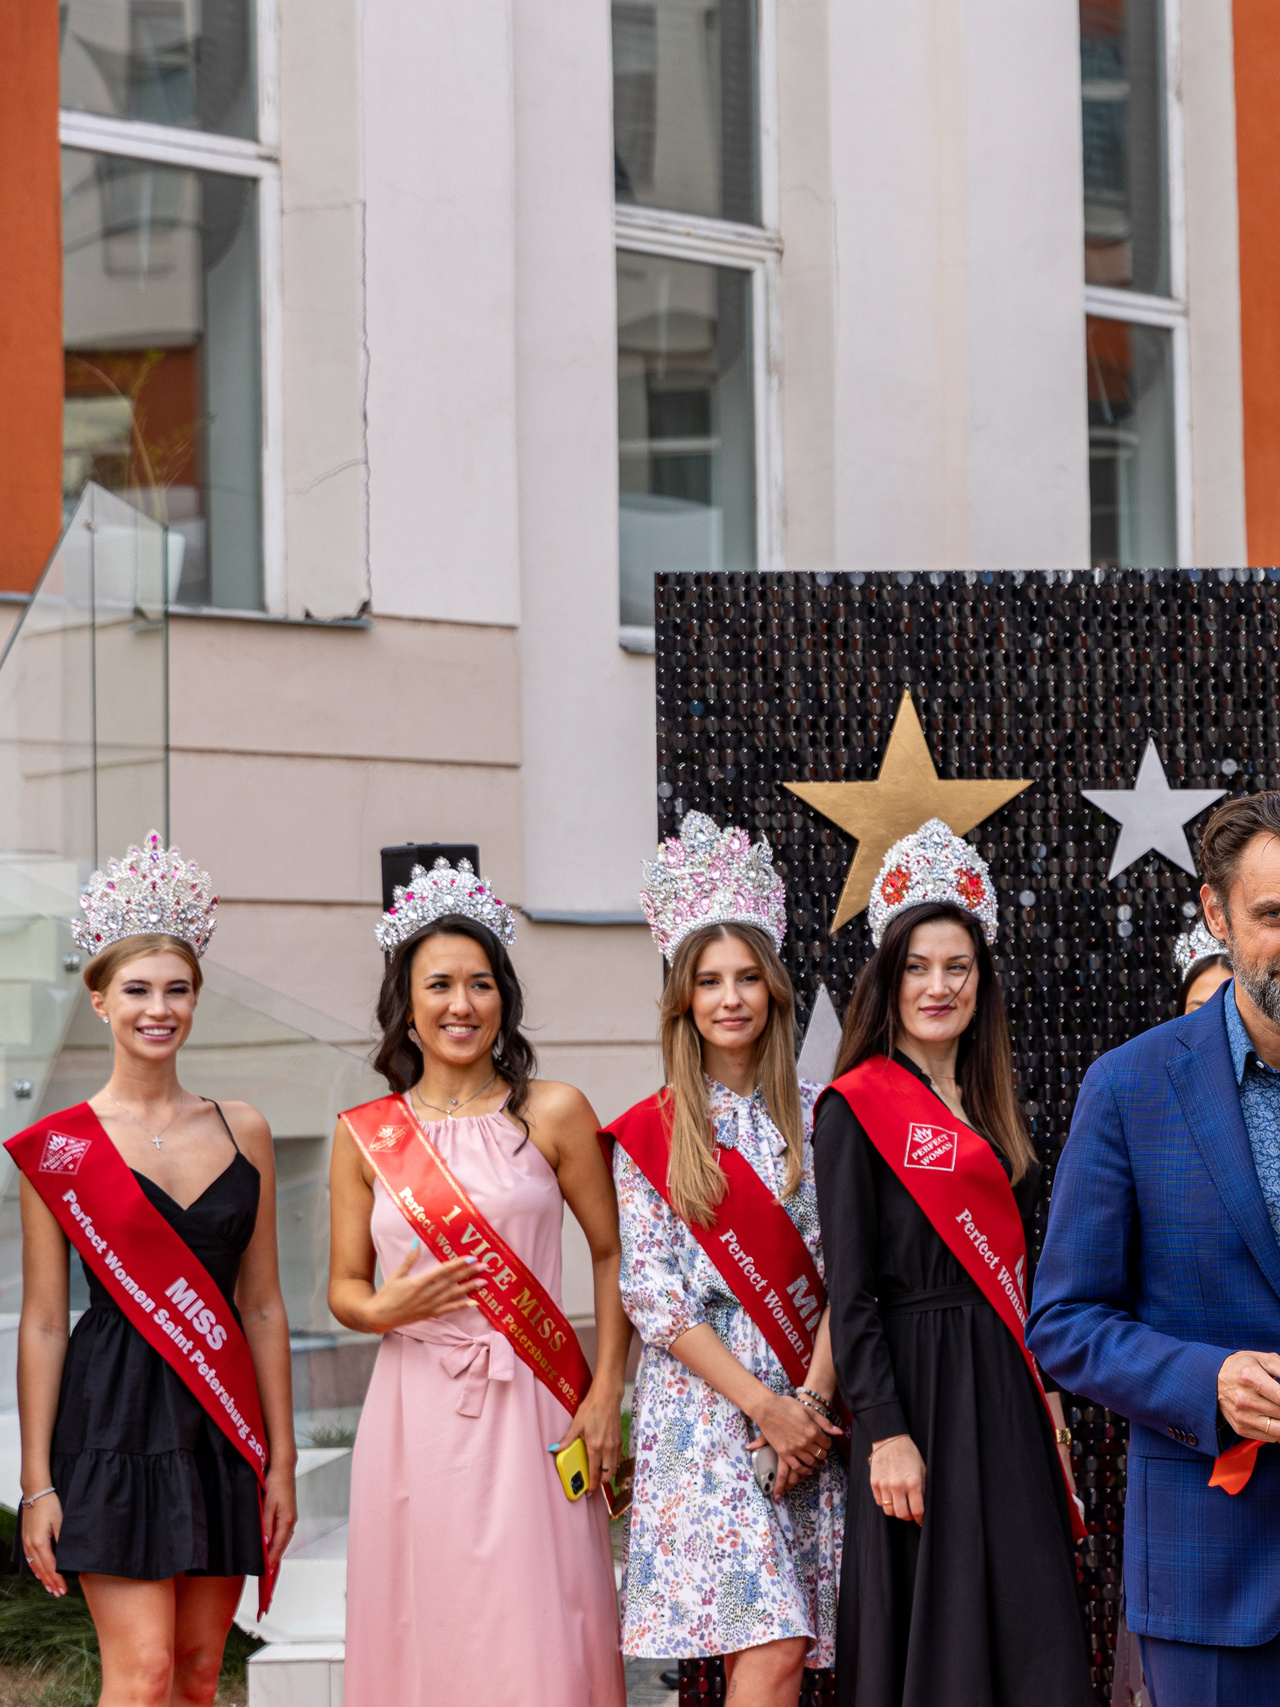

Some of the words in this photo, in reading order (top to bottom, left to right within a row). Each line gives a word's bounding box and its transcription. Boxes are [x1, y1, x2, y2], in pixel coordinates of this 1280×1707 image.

[911, 1133, 949, 1161] PERFECT
[920, 1141, 954, 1166] WOMAN
[62, 1189, 108, 1254] Perfect
[104, 1249, 156, 1313] Women
[153, 1308, 194, 1354] Saint
[189, 1349, 251, 1440] Petersburg
[164, 1276, 228, 1350] MISS
[398, 1186, 436, 1234] Perfect
[478, 1287, 505, 1316] aint
[501, 1312, 558, 1380] Petersburg
[556, 1376, 578, 1405] 2022
[441, 1205, 462, 1226] 1
[460, 1222, 518, 1291] VICE
[511, 1287, 567, 1352] MISS
[719, 1228, 768, 1292] Perfect
[763, 1288, 805, 1355] Woman
[955, 1208, 1000, 1270] Perfect
[996, 1265, 1027, 1327] Woman
